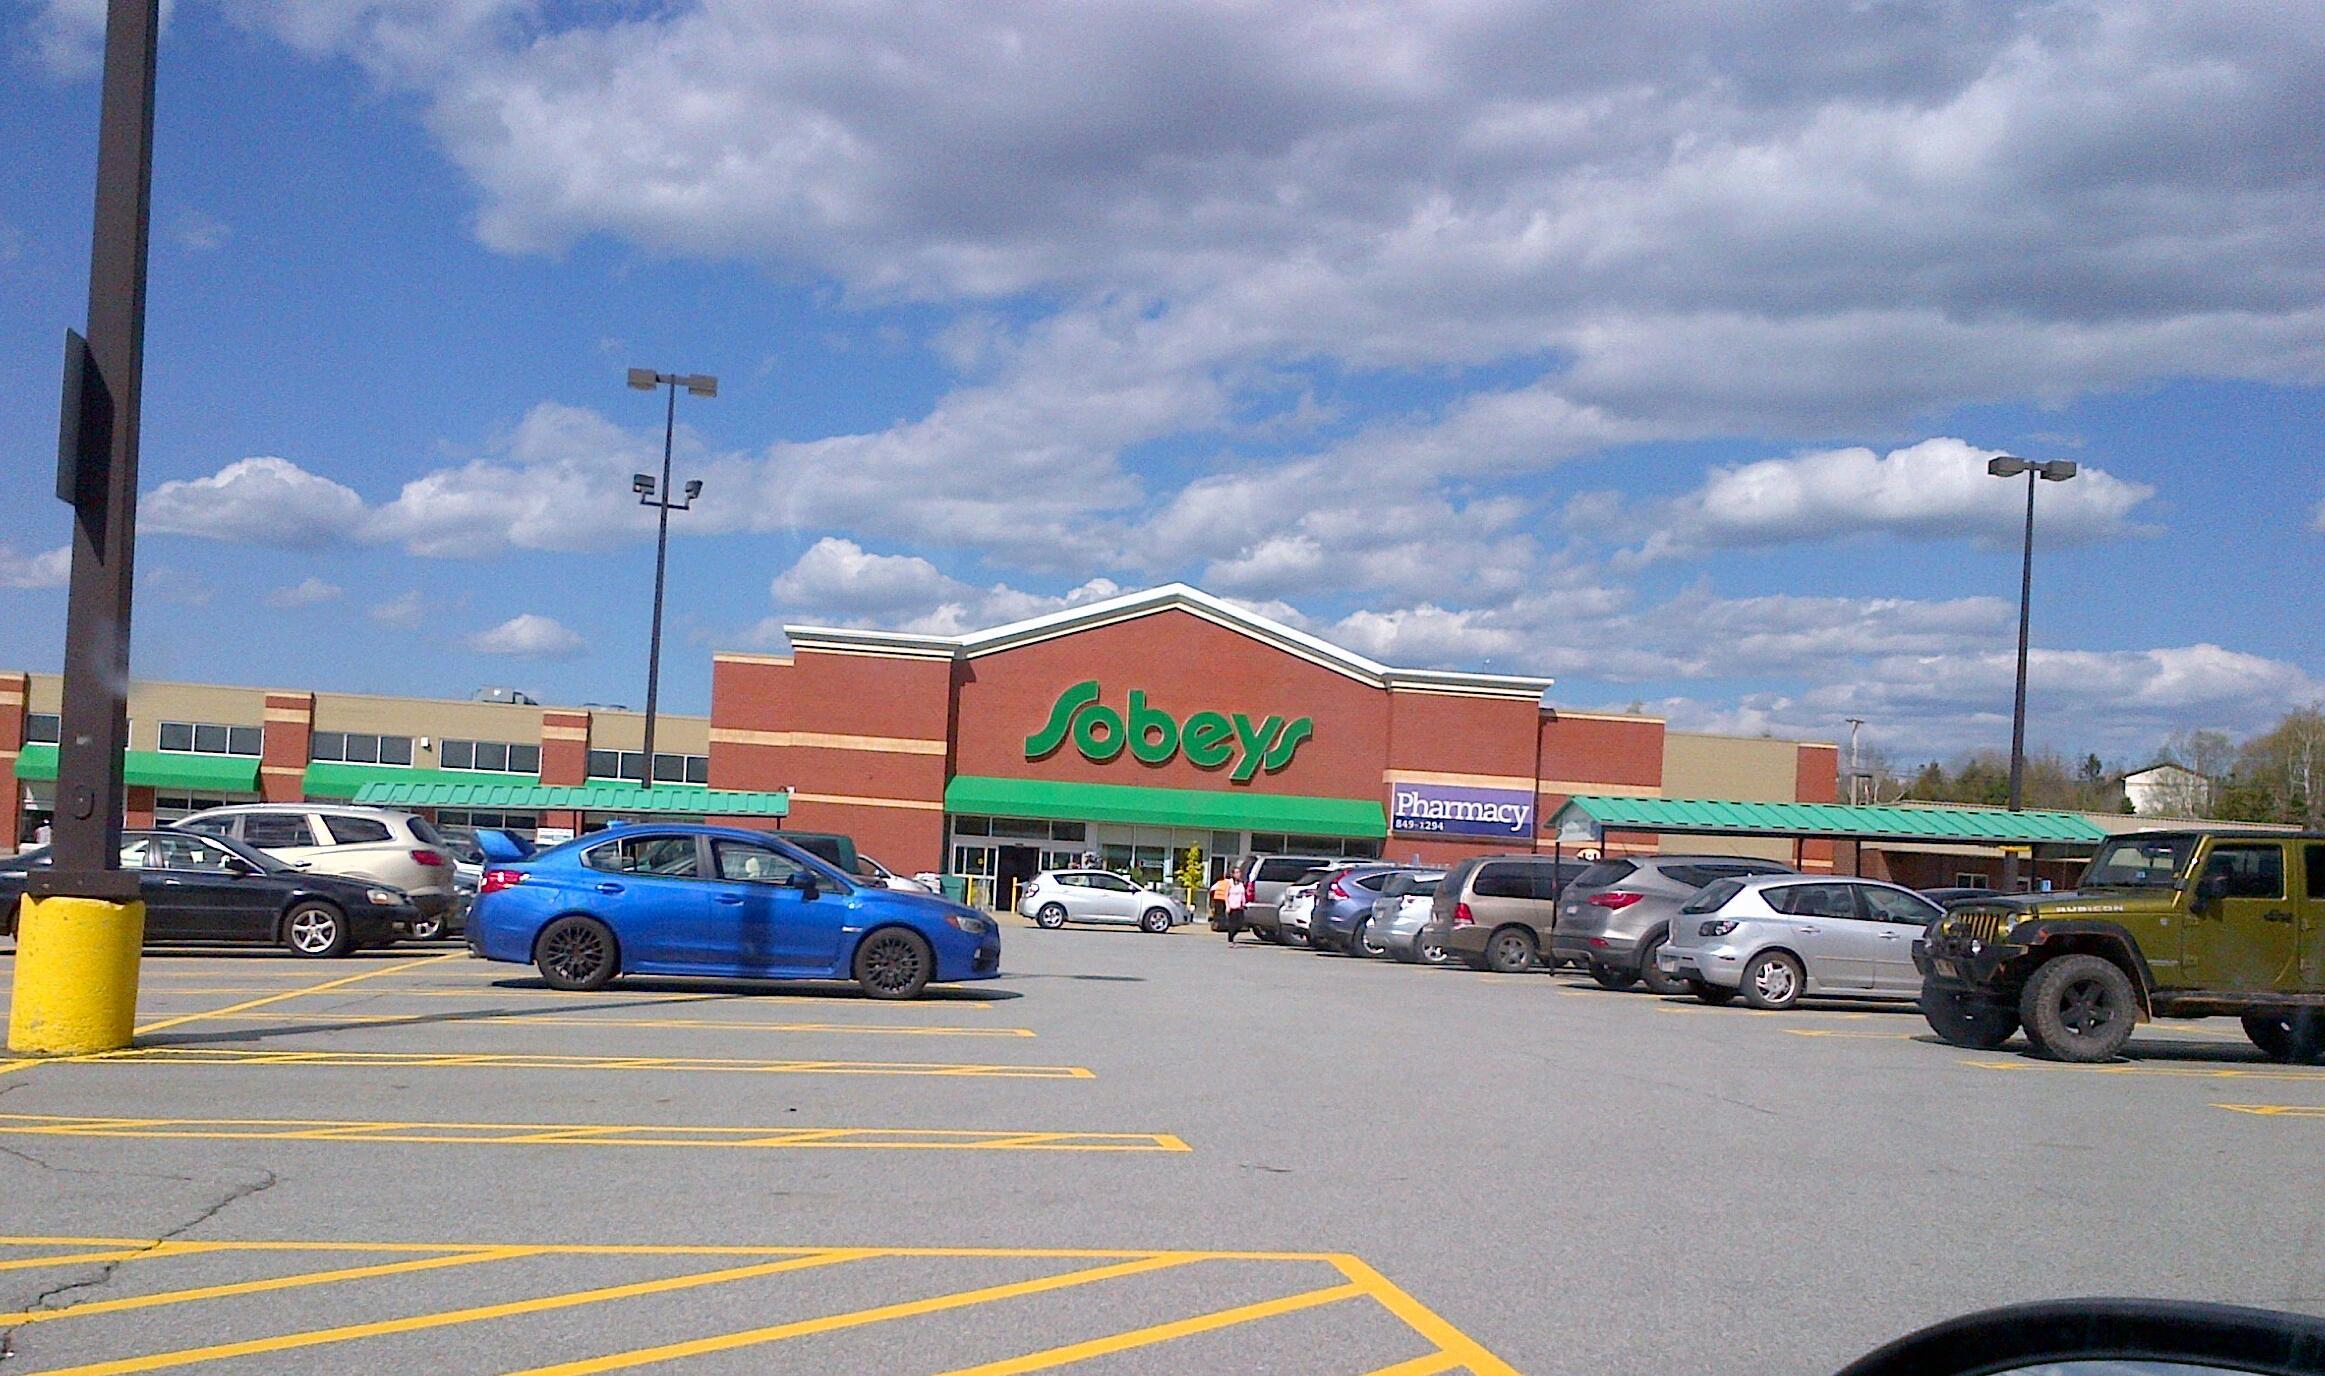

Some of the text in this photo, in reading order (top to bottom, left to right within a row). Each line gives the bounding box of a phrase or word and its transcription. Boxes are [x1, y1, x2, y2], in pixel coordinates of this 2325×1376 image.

[1025, 680, 1312, 780] Sobeys
[1395, 791, 1529, 832] Pharmacy
[2055, 905, 2124, 913] RUBICON
